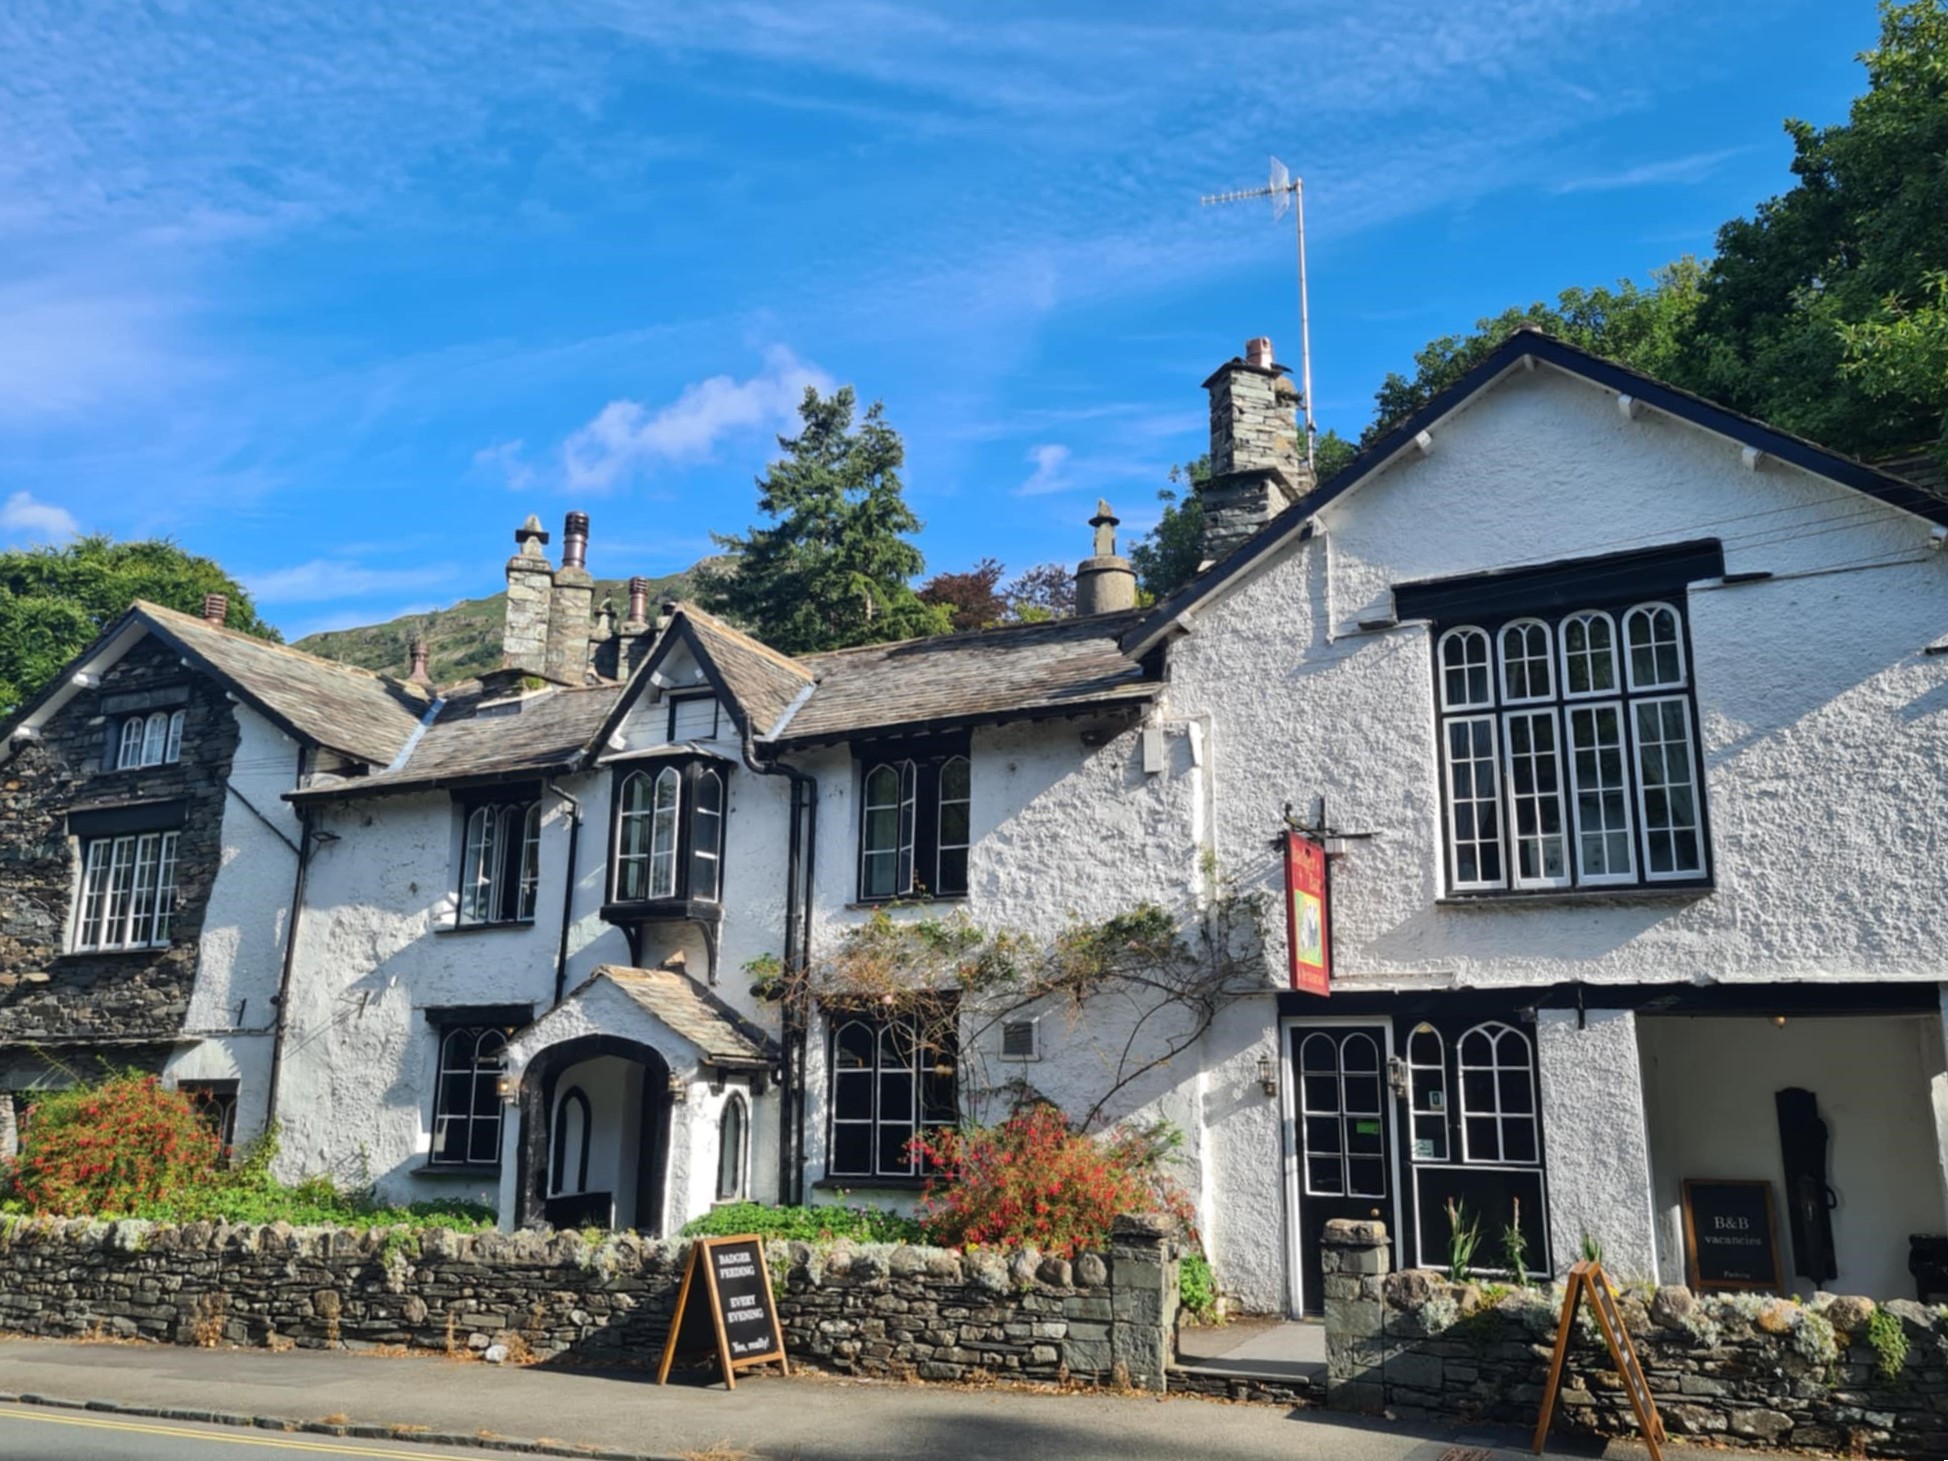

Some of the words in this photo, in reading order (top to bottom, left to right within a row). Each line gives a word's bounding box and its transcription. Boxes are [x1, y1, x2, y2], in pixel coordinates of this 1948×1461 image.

[1714, 1216, 1750, 1229] B&B
[718, 1252, 751, 1265] BADGER
[720, 1266, 755, 1279] FEEDING
[730, 1294, 756, 1308] EVERY
[727, 1308, 764, 1323] EVENING
